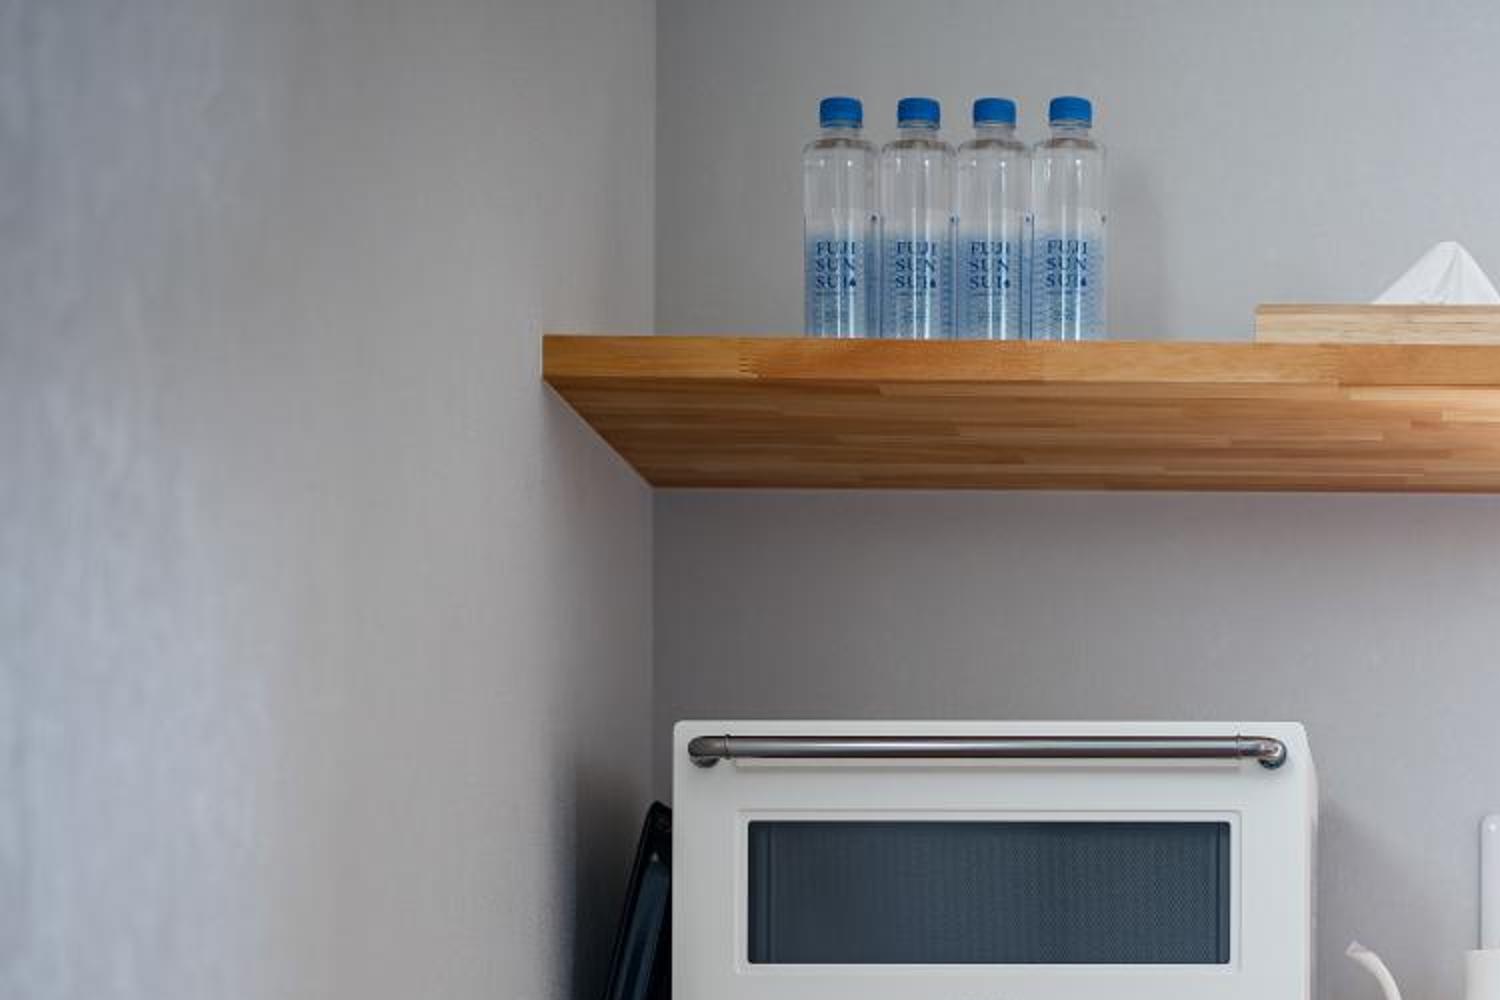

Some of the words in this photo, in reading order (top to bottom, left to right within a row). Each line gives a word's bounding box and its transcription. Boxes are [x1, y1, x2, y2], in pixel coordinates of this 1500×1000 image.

[817, 241, 855, 255] FUJI
[897, 241, 937, 255] FUJI
[970, 241, 1009, 255] FUJI
[1047, 240, 1087, 254] FUJI
[815, 258, 855, 272] SUN
[896, 258, 935, 272] SUN
[969, 258, 1009, 272] SUN
[1046, 257, 1086, 271] SUN
